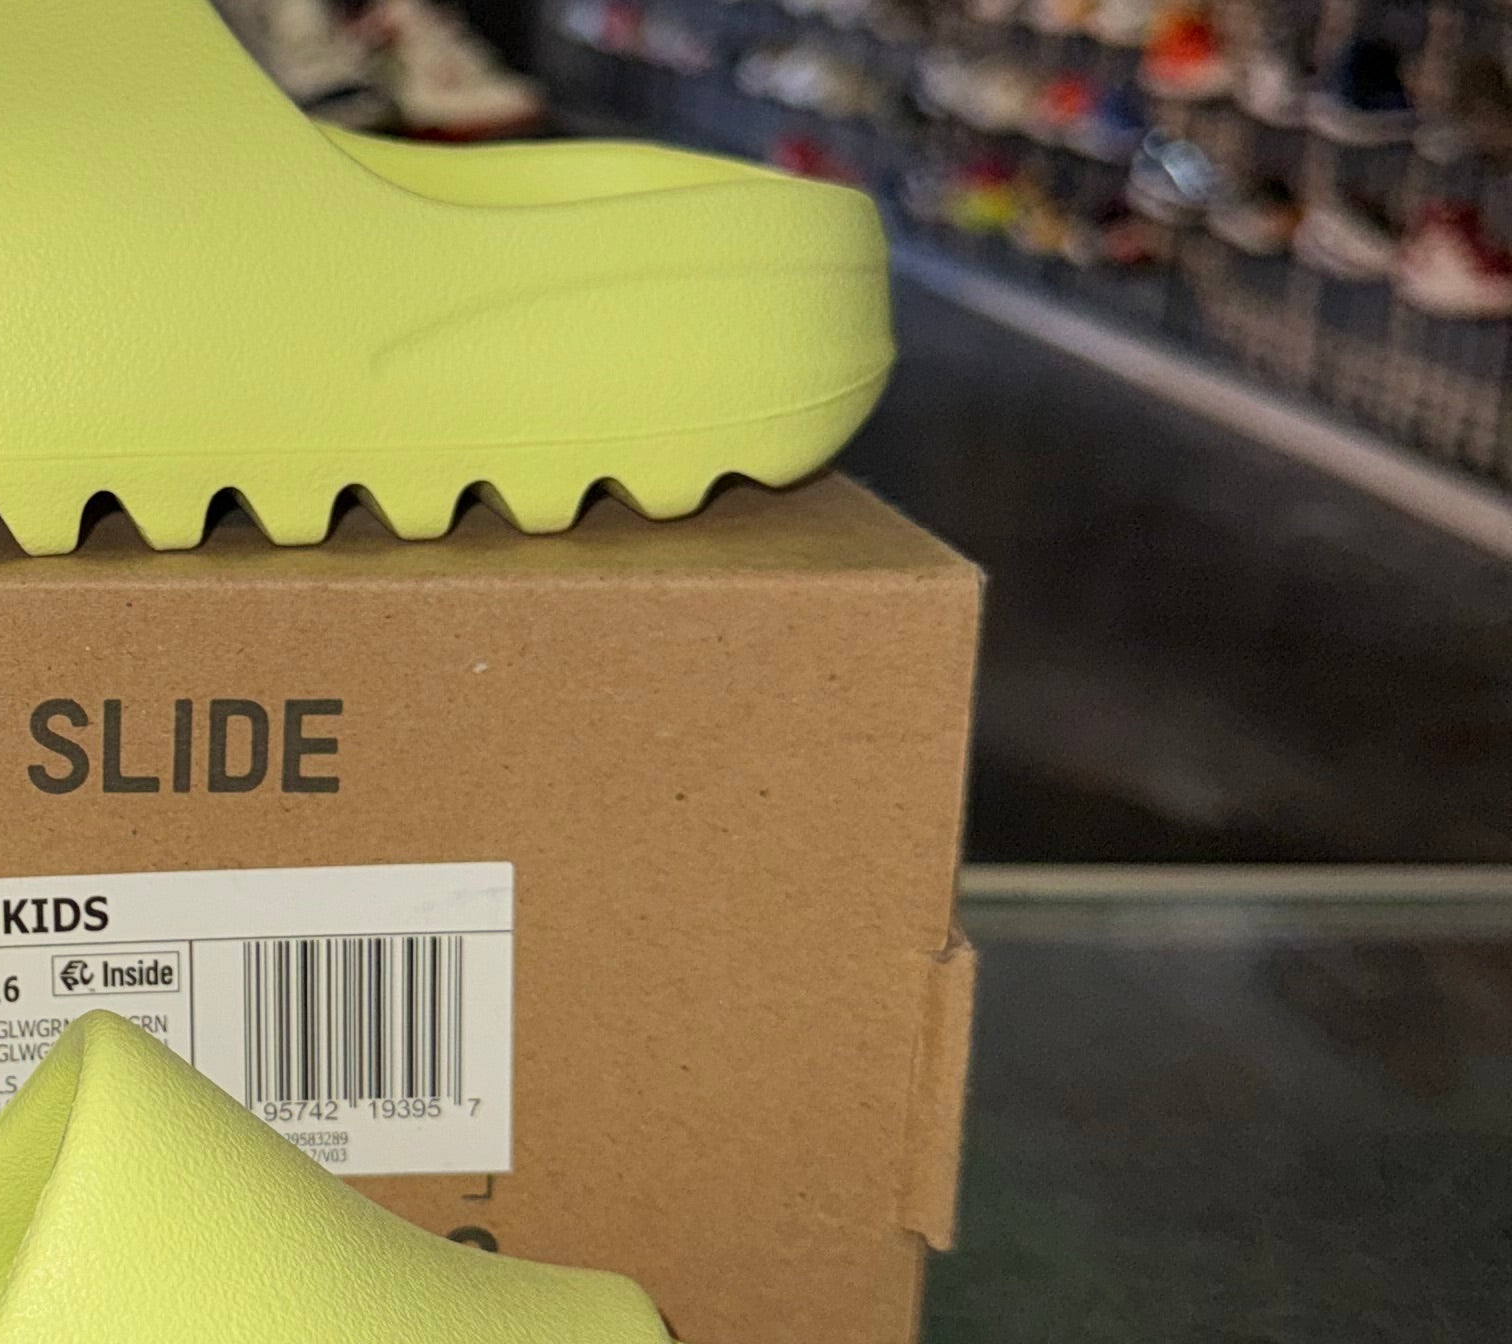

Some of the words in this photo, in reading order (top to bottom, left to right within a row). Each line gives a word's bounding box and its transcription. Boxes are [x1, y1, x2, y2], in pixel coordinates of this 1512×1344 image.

[27, 698, 343, 795] SLIDE
[2, 896, 109, 935] KIDS
[102, 959, 173, 987] Inside
[263, 1100, 339, 1123] 95742
[368, 1098, 441, 1119] 19395
[467, 1097, 481, 1118] 7
